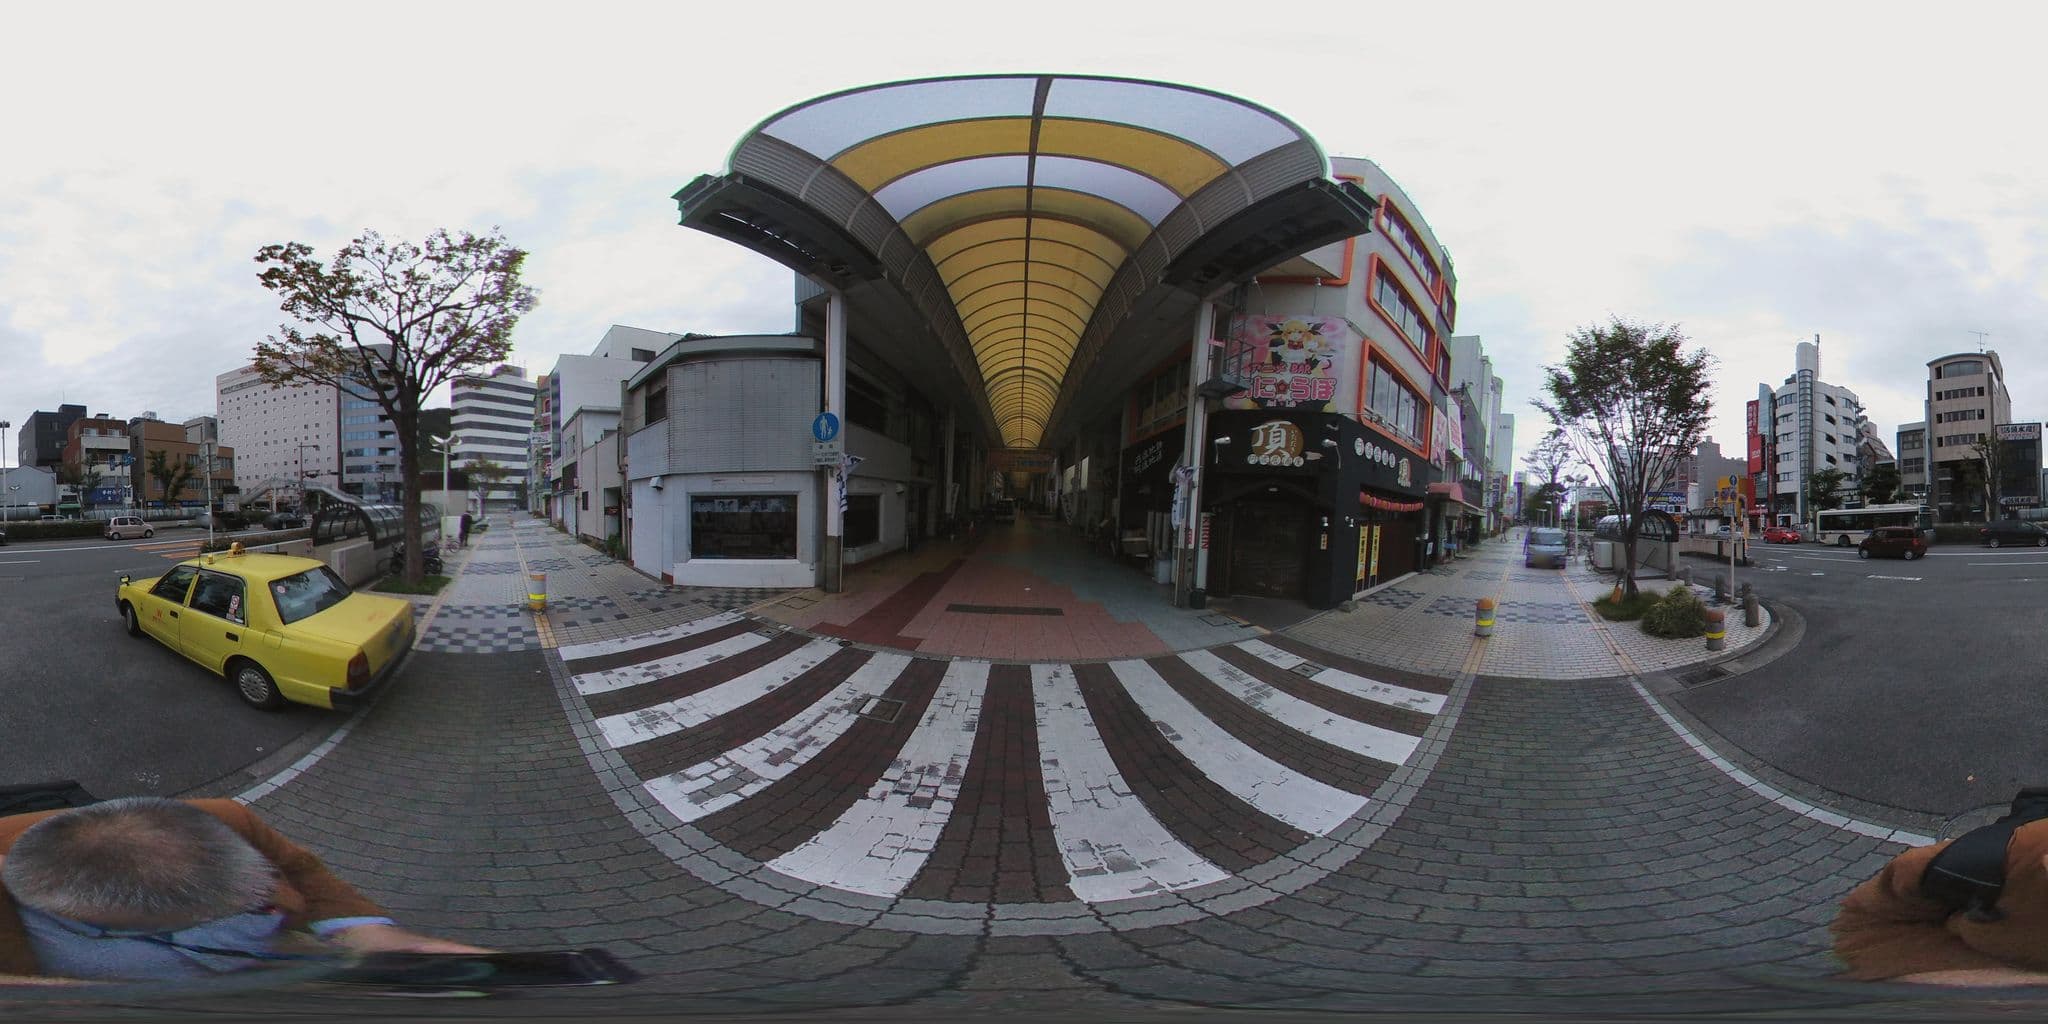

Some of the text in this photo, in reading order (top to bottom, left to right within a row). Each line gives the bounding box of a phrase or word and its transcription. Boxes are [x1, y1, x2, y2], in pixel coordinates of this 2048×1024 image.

[1290, 363, 1312, 375] BAR
[1249, 420, 1293, 459] 頂
[1201, 515, 1210, 550] KIRIN
